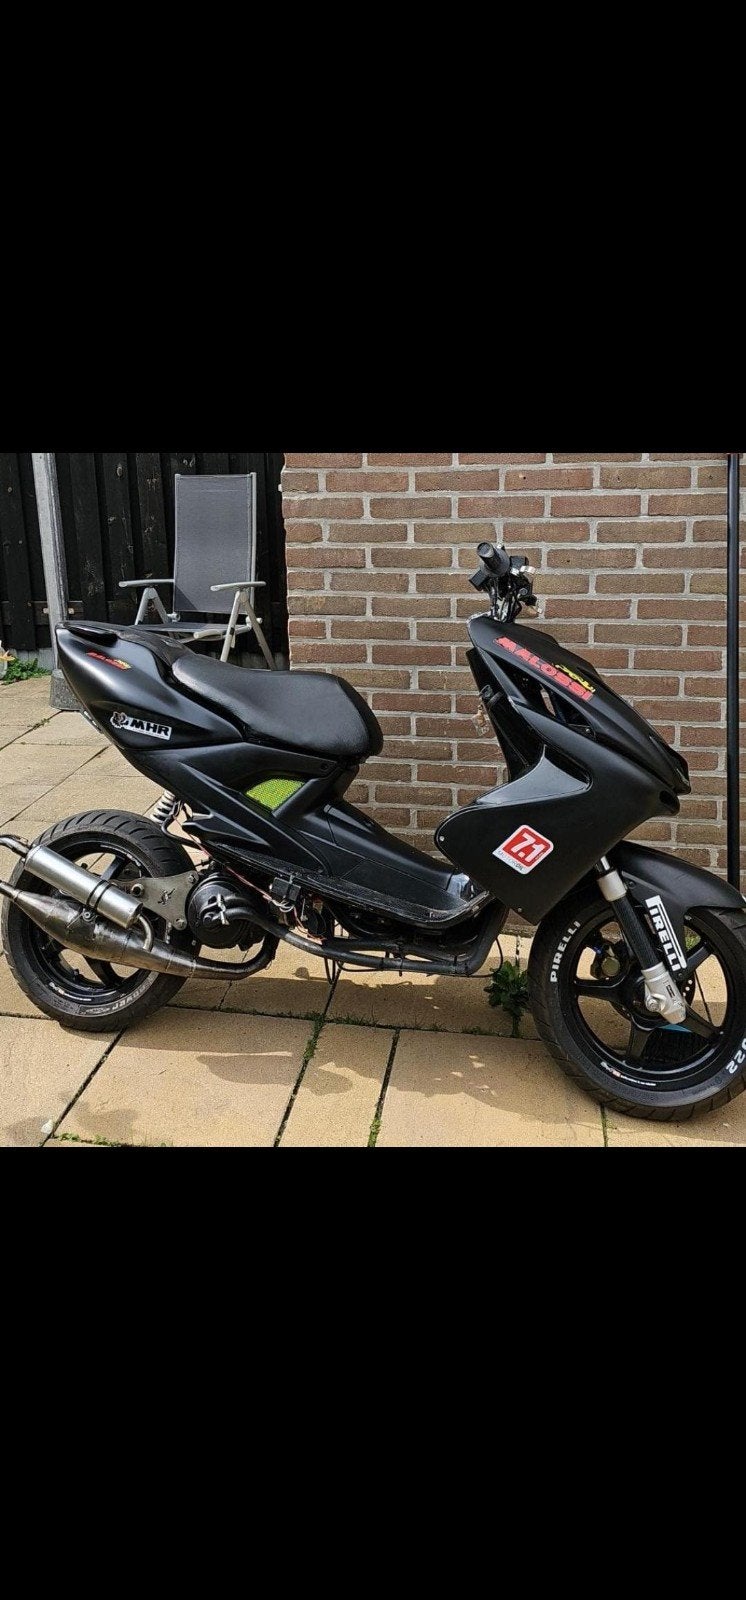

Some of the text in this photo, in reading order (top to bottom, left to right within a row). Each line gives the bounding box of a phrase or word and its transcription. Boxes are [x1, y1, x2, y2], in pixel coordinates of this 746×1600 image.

[494, 636, 593, 701] MALOSSI
[130, 719, 169, 736] MHR
[510, 832, 546, 862] 7.1
[550, 921, 581, 983] PIRELLI
[645, 895, 687, 972] PIRELLI
